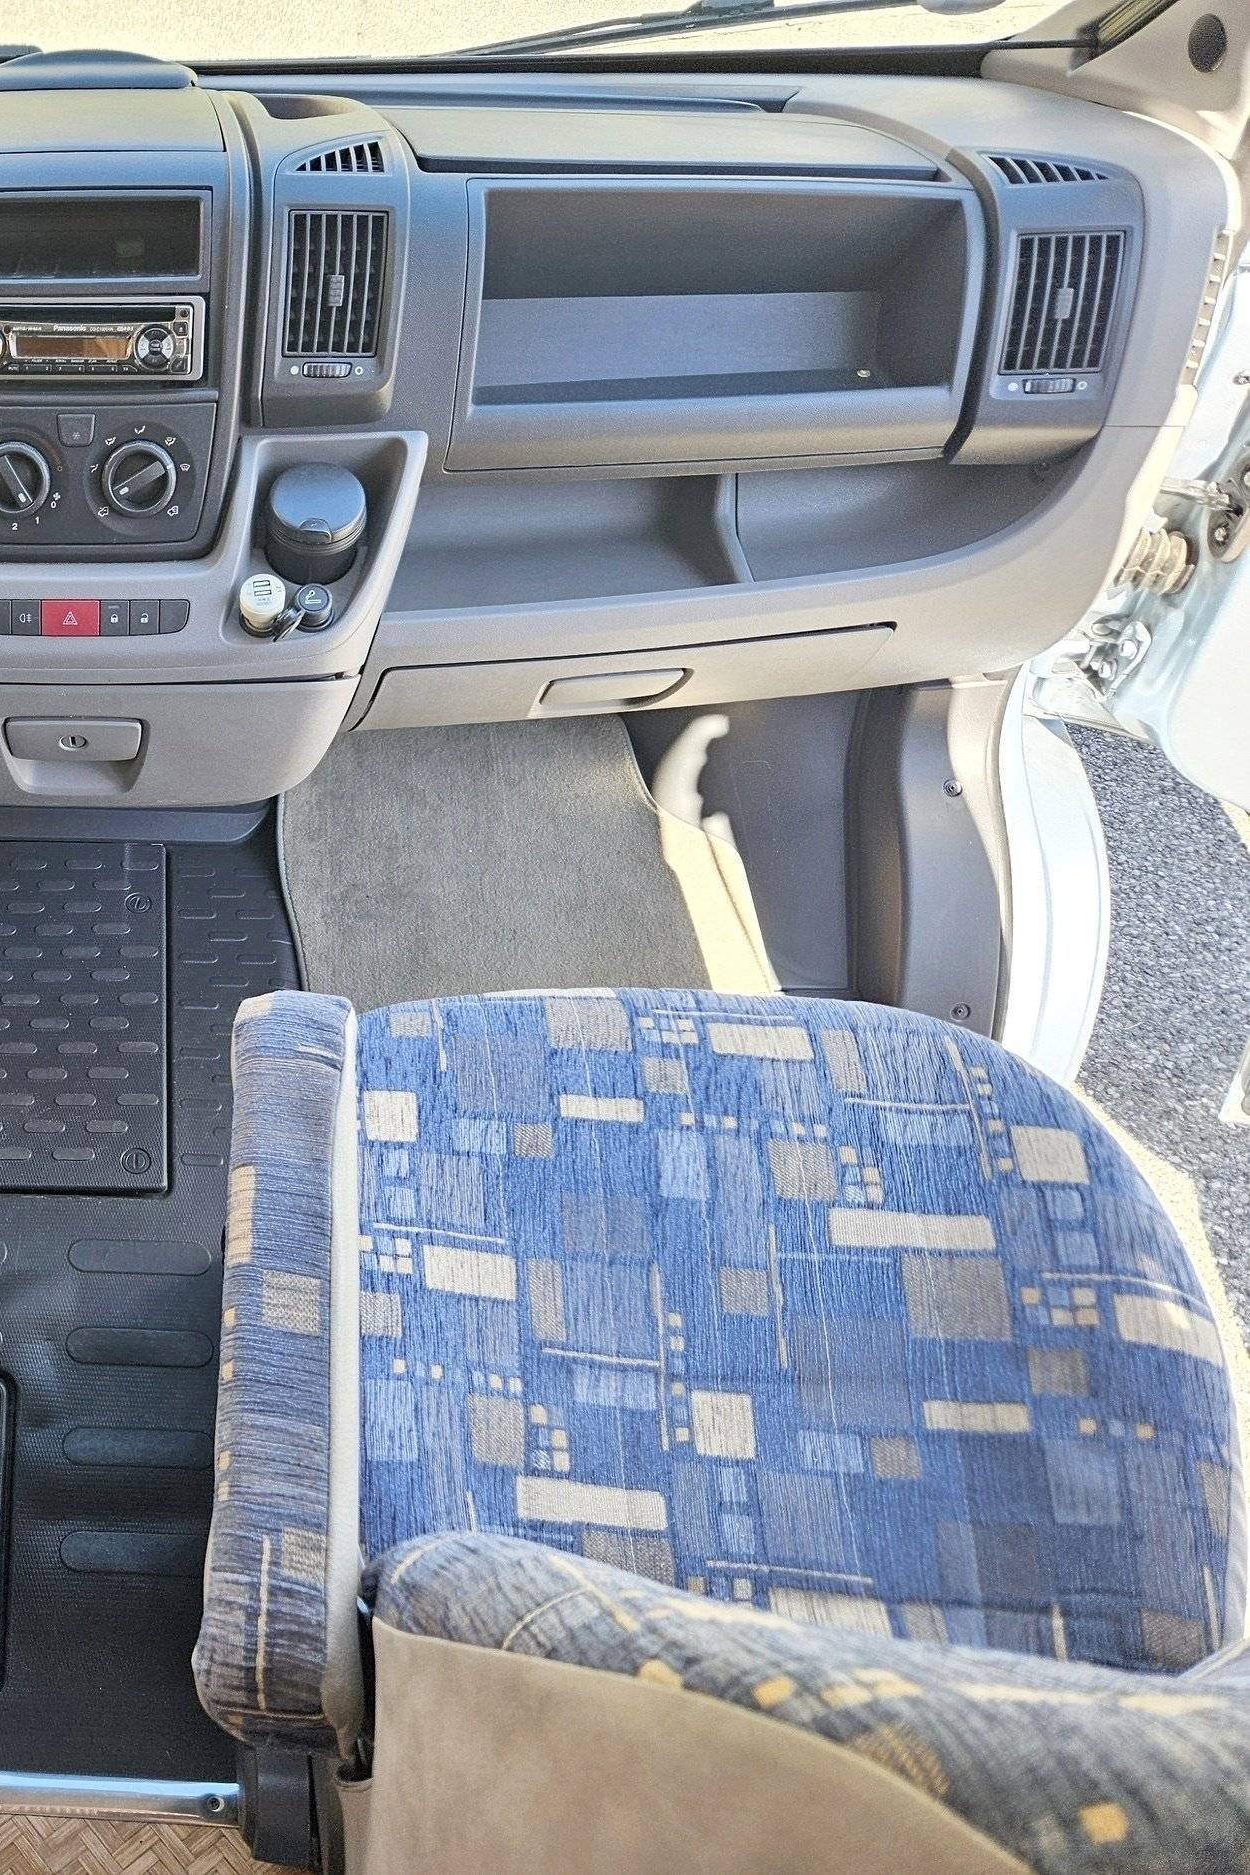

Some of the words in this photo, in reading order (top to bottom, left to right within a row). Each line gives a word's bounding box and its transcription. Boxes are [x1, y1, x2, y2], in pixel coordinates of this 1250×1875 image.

[53, 324, 87, 332] Panasonic
[50, 500, 56, 508] 0
[35, 516, 40, 524] 1
[11, 522, 18, 530] 2
